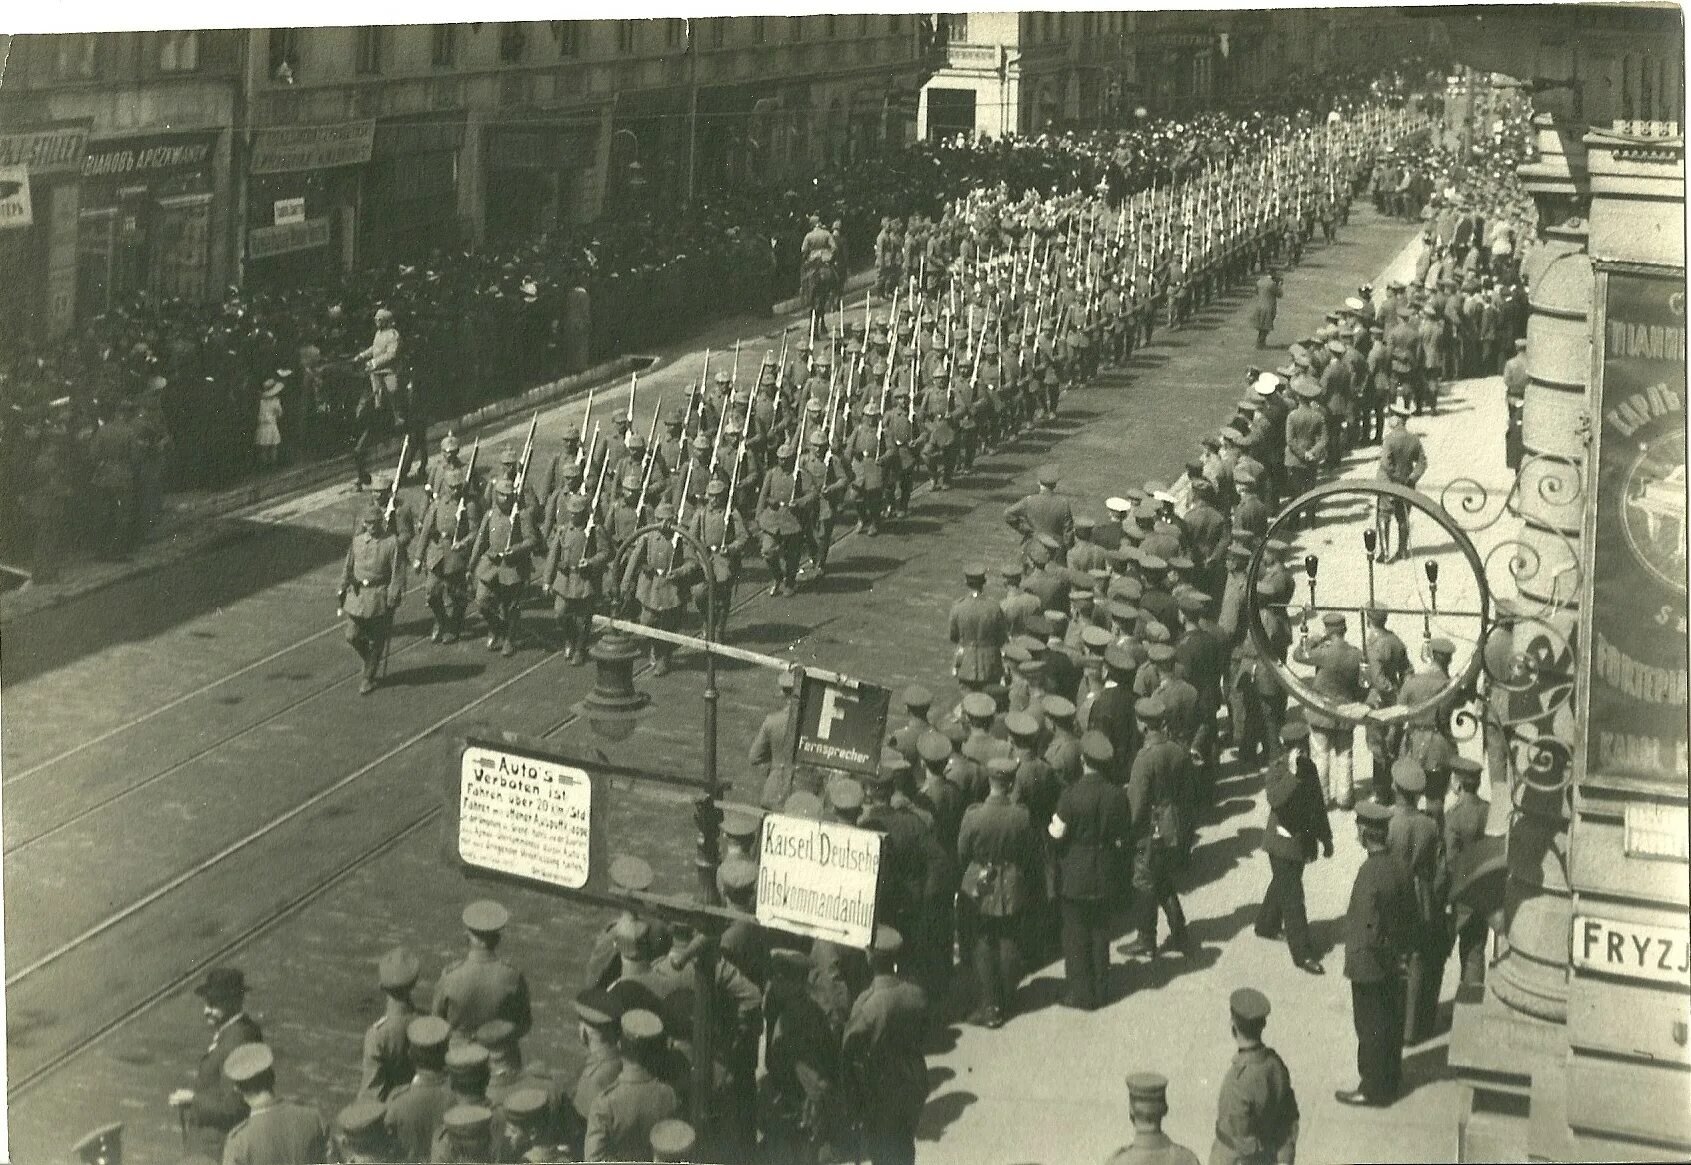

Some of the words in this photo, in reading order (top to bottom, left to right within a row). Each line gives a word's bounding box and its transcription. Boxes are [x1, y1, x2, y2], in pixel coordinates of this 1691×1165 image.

[817, 687, 860, 740] F
[798, 735, 870, 763] Fernsprecher
[474, 769, 540, 795] Verboten
[549, 789, 566, 801] ist
[499, 757, 553, 783] Auto's
[467, 782, 503, 802] Fahren
[760, 867, 874, 928] Ortskommandantur
[1584, 921, 1689, 973] FRYZJ
